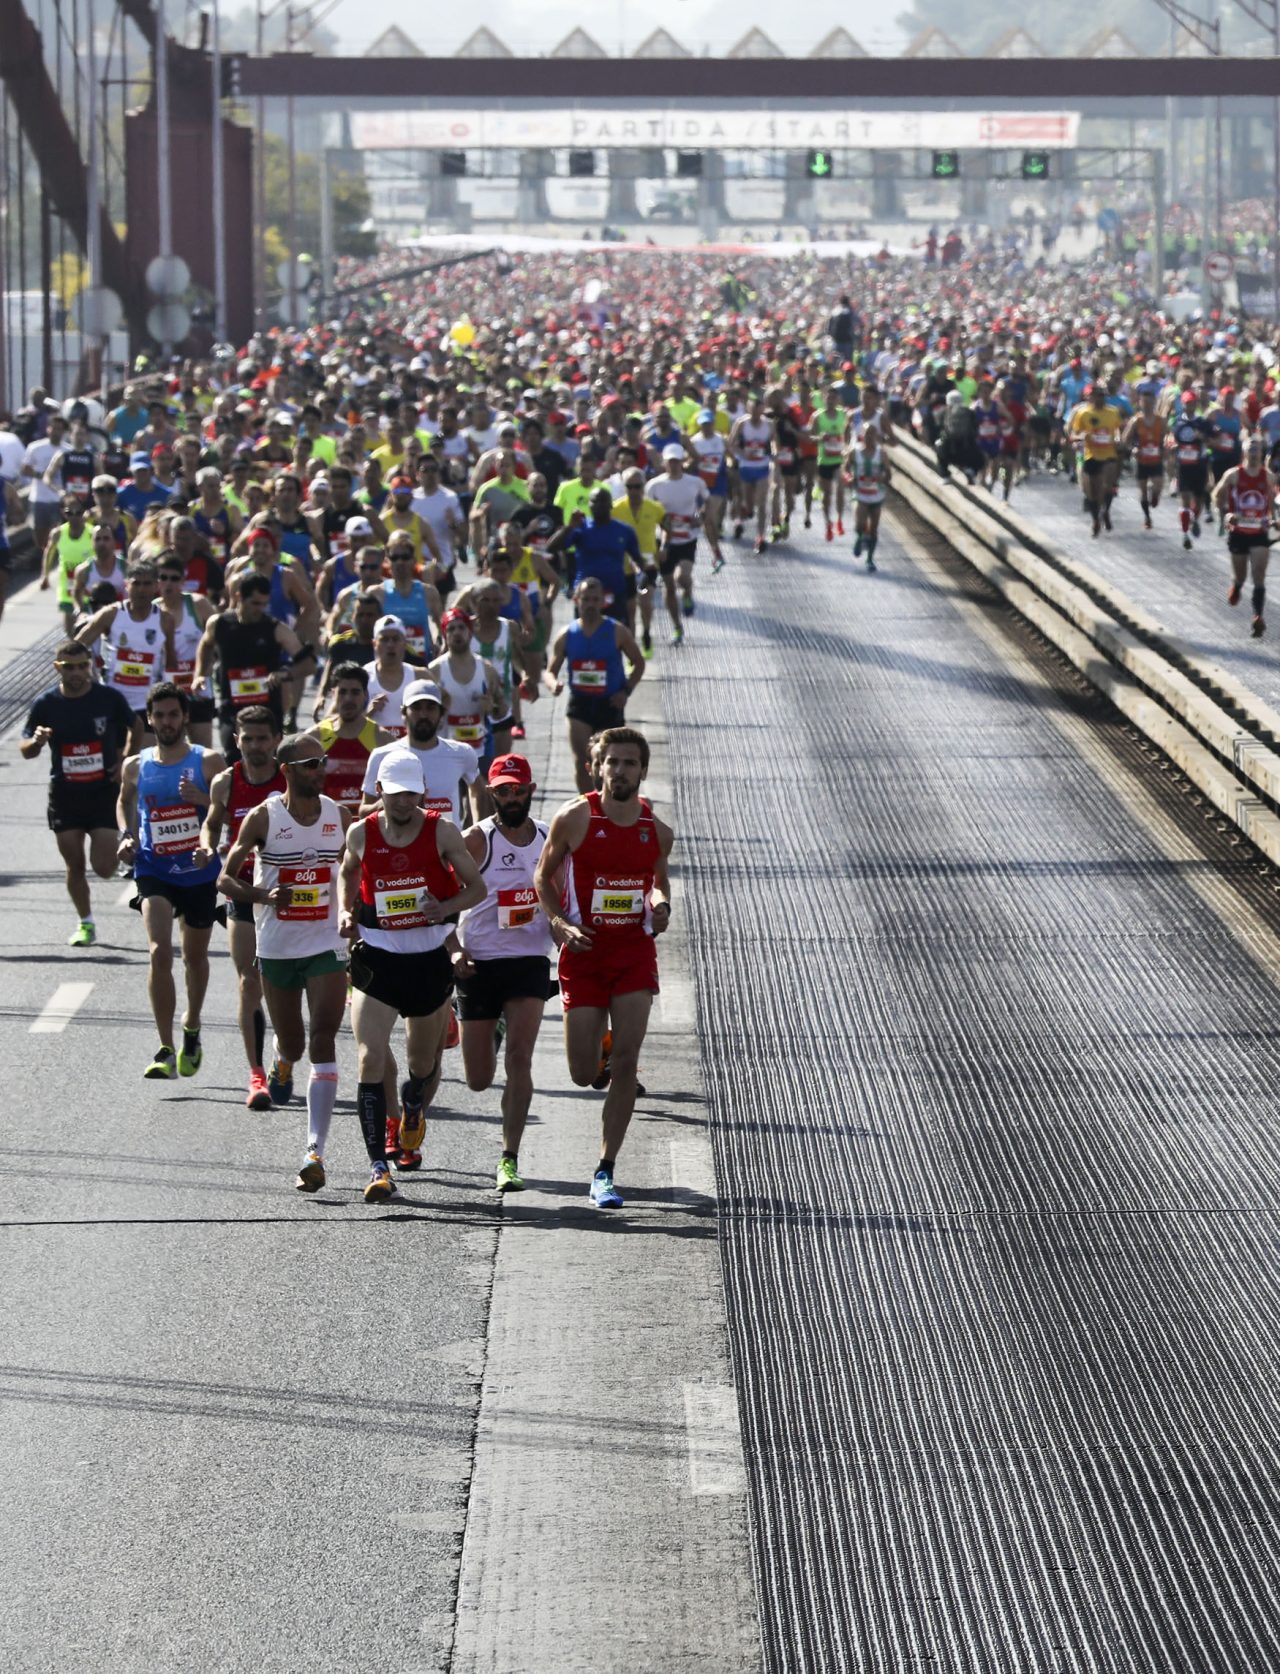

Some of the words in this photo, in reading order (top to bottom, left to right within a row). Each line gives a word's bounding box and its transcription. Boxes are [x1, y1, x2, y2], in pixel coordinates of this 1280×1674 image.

[573, 119, 725, 138] PARTIDA
[160, 806, 197, 819] vodafone
[157, 822, 190, 837] 34013
[295, 868, 317, 885] edp
[386, 875, 426, 888] vodafone
[609, 879, 645, 887] vodafone
[294, 892, 314, 903] 336
[514, 888, 534, 905] edp
[386, 897, 417, 911] 19567
